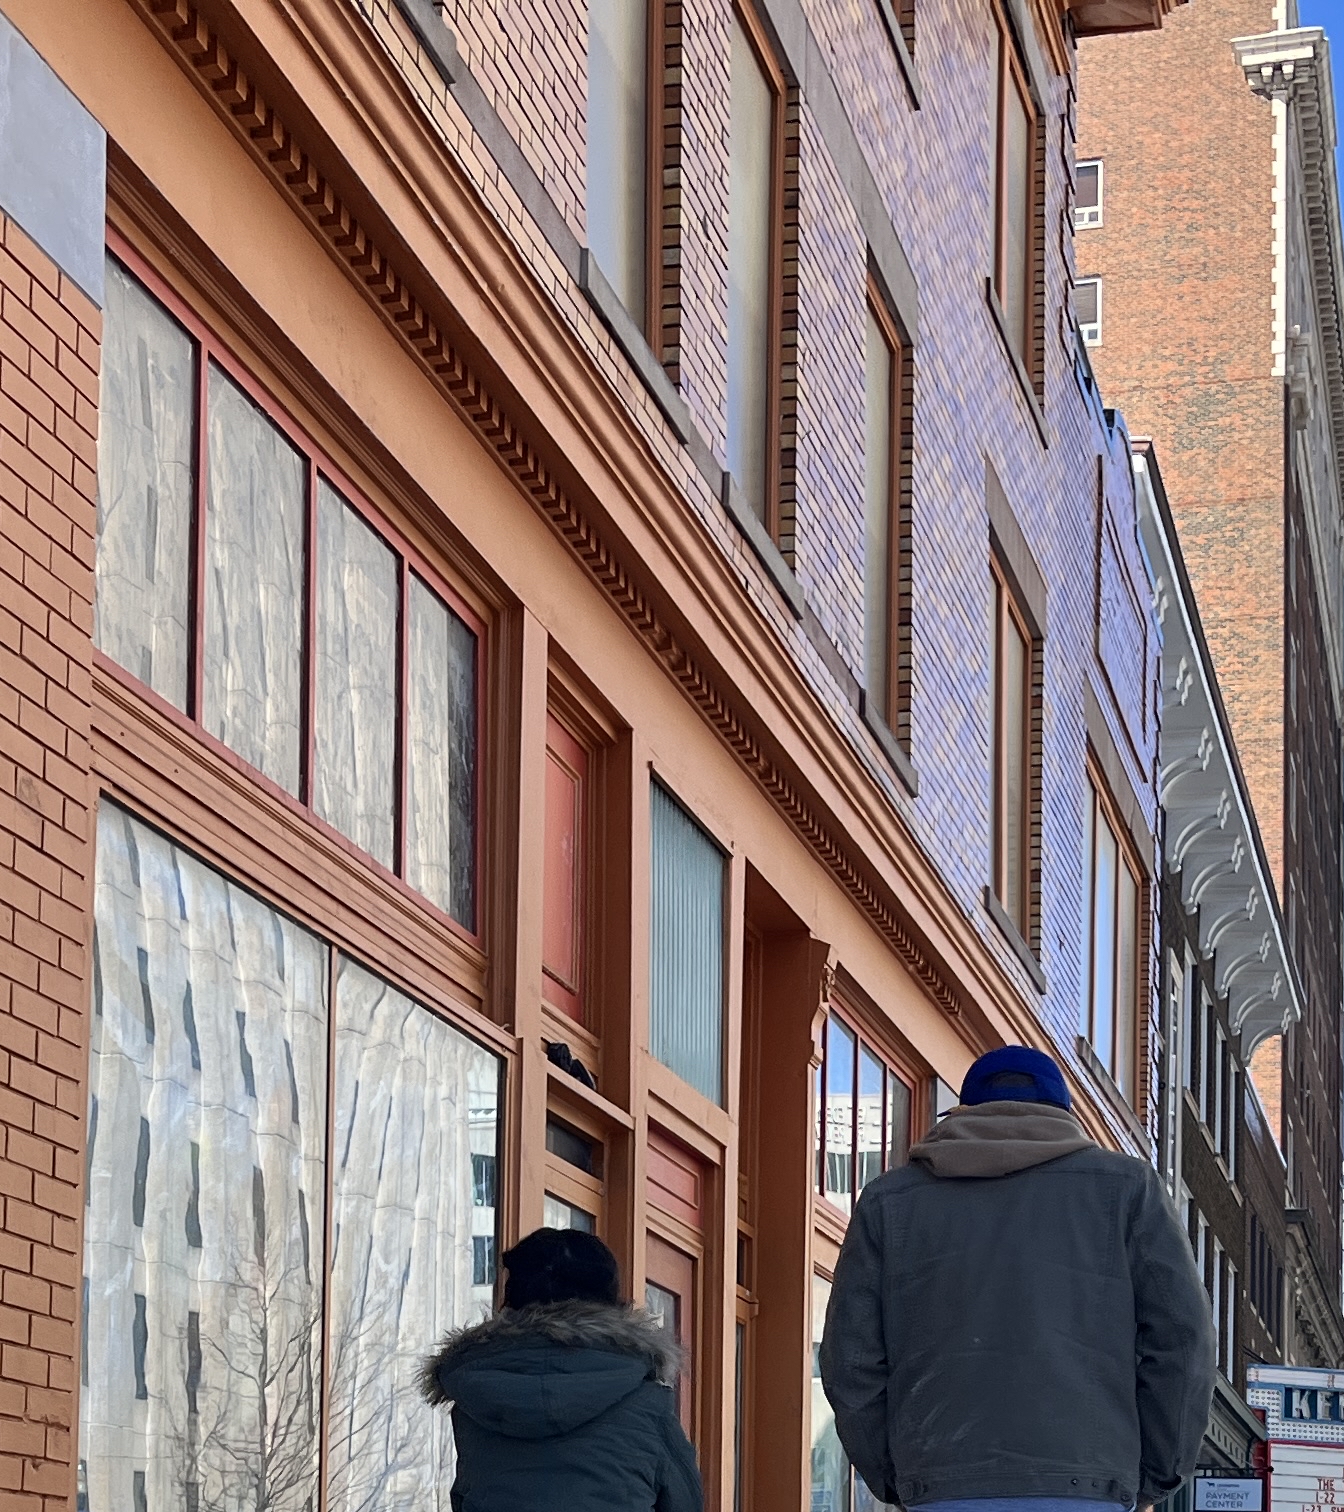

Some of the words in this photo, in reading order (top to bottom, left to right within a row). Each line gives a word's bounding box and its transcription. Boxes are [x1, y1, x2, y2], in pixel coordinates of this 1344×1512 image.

[1317, 1479, 1335, 1491] THE
[1206, 1492, 1250, 1500] PAYMENT
[1316, 1492, 1335, 1504] 1-22
[1206, 1500, 1243, 1508] CENTER
